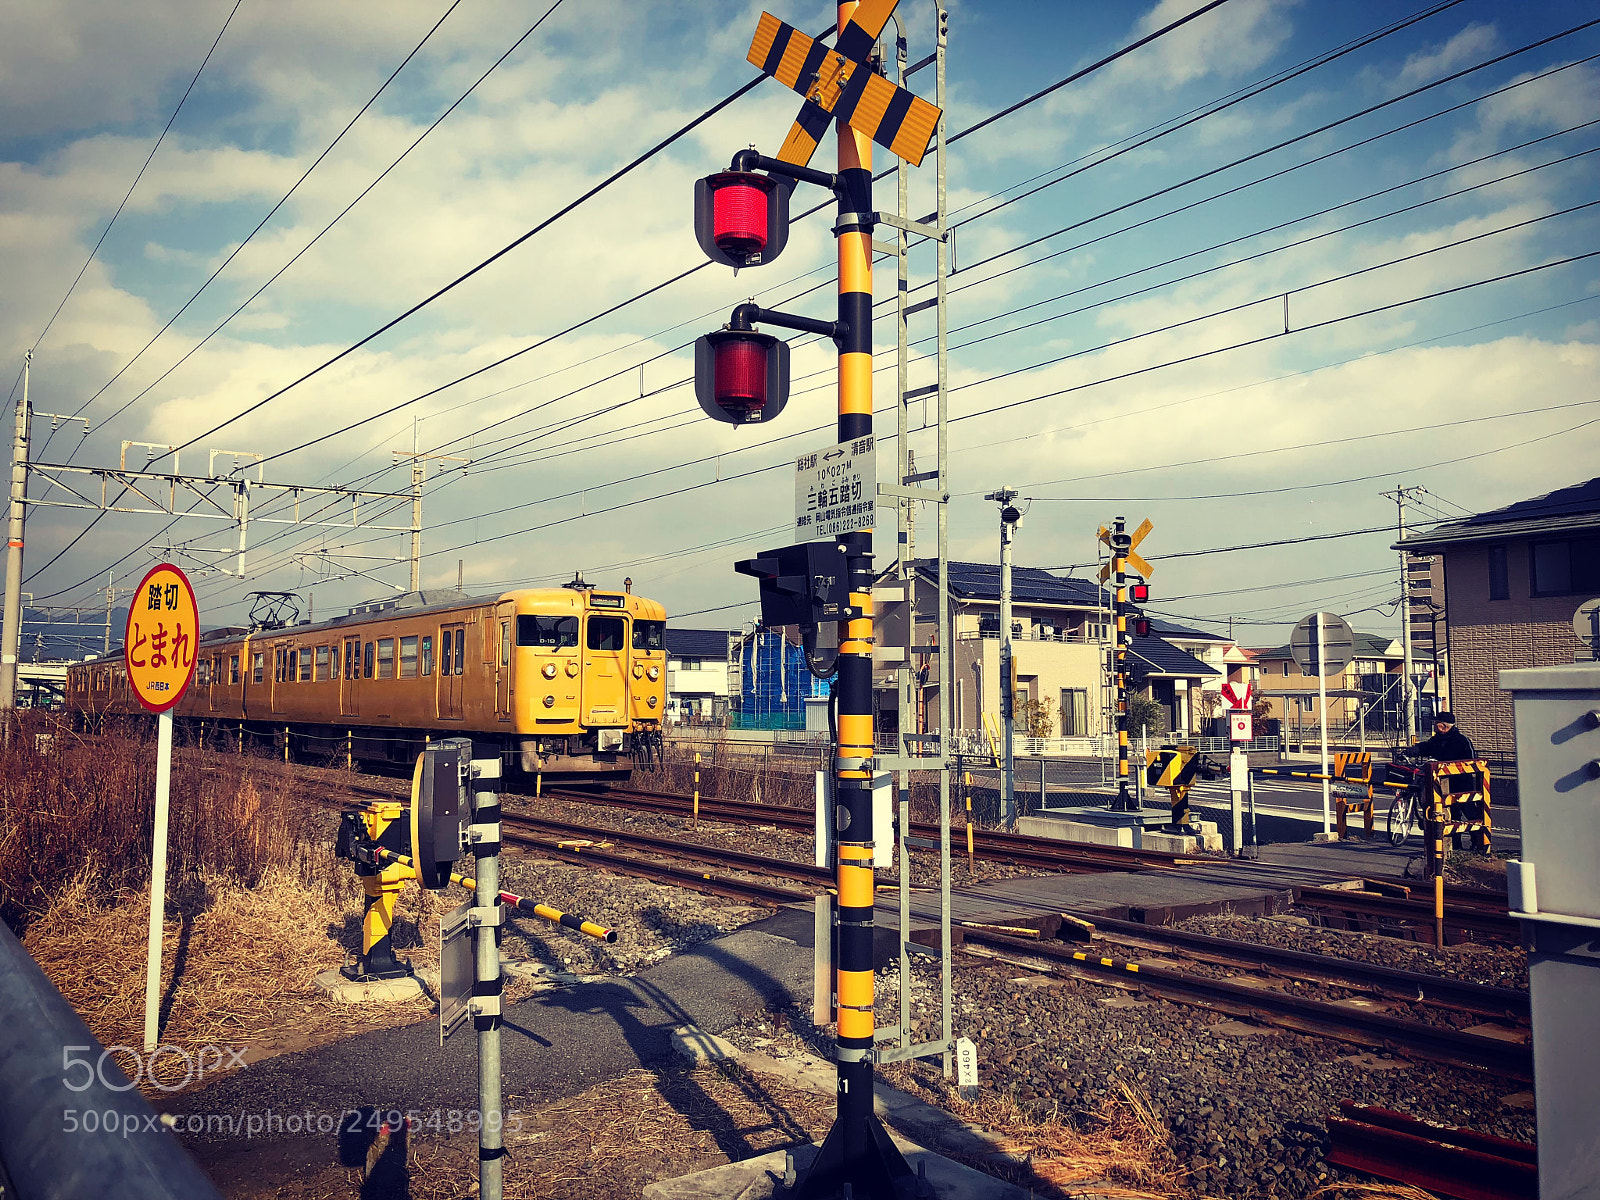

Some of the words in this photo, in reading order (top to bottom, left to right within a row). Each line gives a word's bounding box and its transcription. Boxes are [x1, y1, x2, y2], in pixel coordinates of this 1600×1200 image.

[797, 454, 818, 472] 総社駅
[850, 437, 874, 457] 清音駅
[807, 480, 863, 511] 三輪五踏切
[147, 583, 179, 611] 踏切
[130, 622, 192, 669] とまれ
[146, 681, 170, 691] JR西日本
